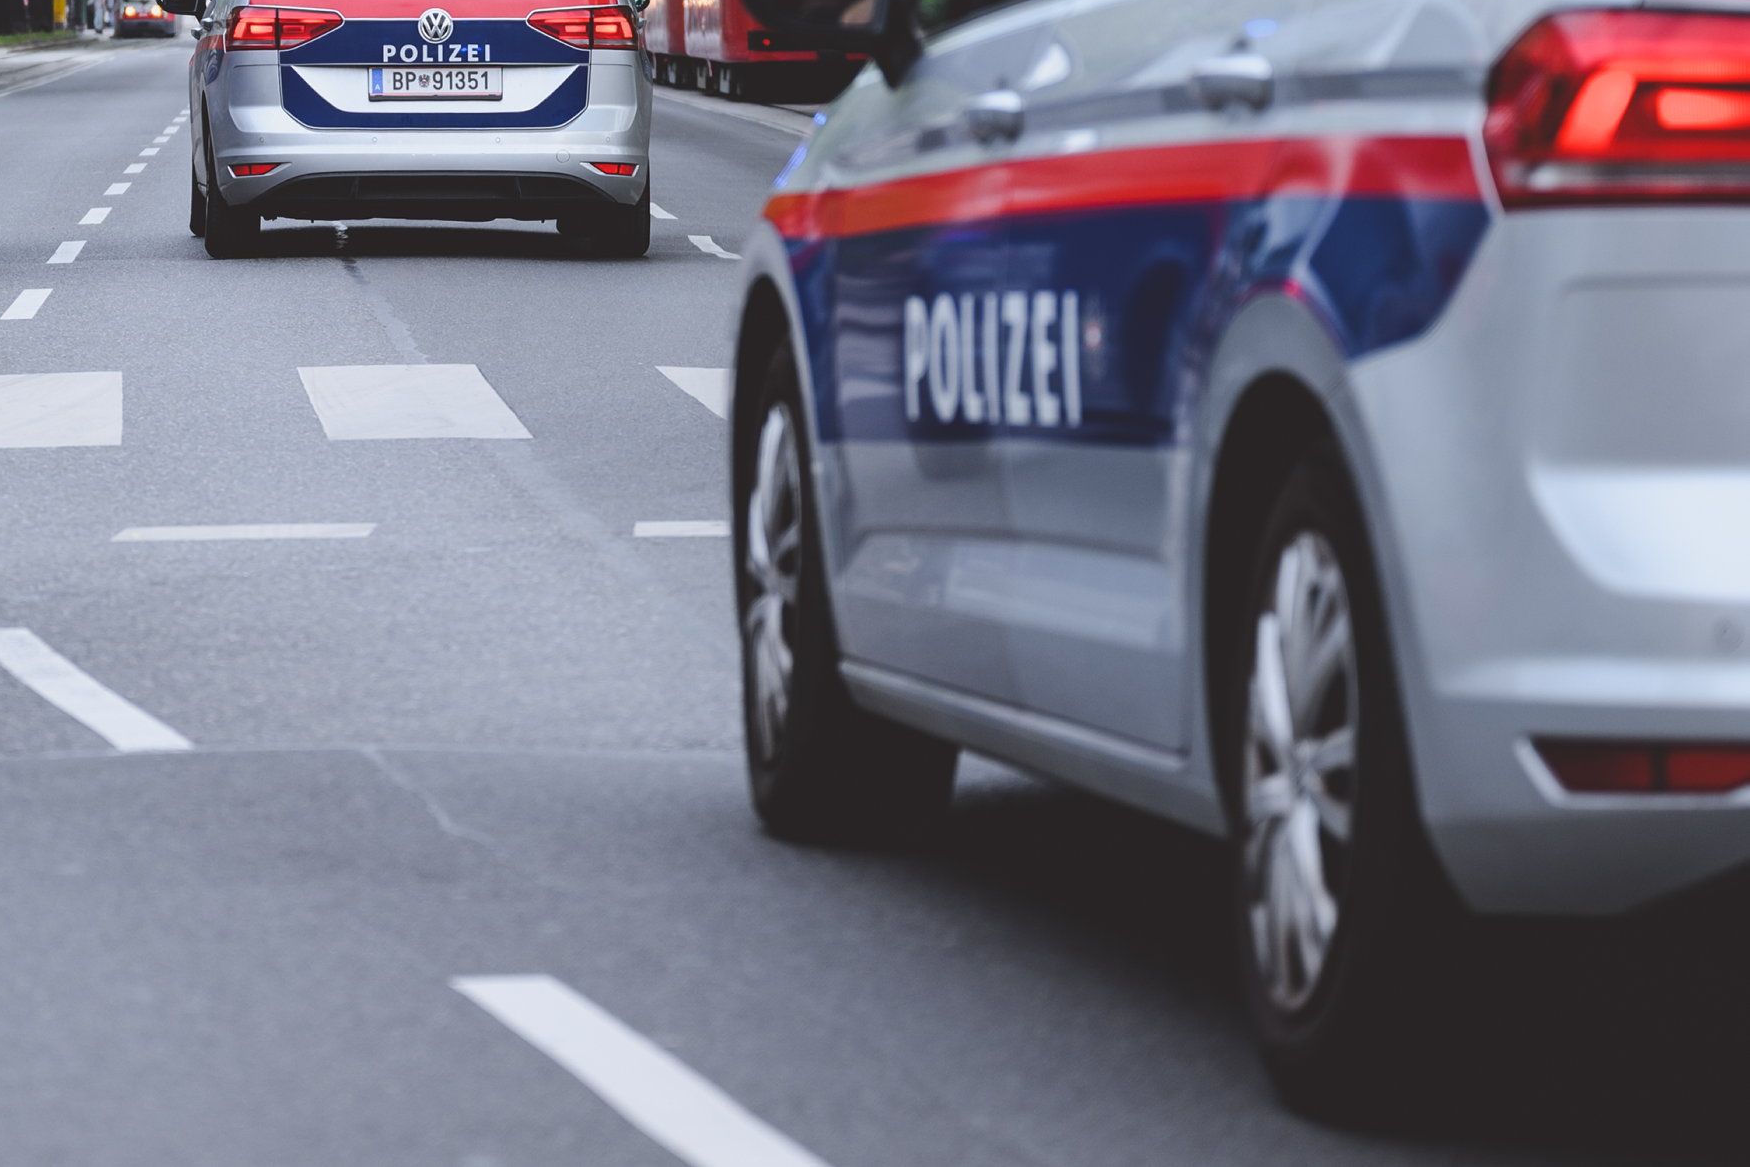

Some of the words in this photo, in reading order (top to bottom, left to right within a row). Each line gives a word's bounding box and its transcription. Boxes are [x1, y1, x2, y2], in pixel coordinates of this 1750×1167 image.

[382, 43, 491, 63] POLIZEI
[392, 71, 416, 91] BP
[432, 70, 489, 91] 91351
[904, 288, 1083, 428] POLIZEI
